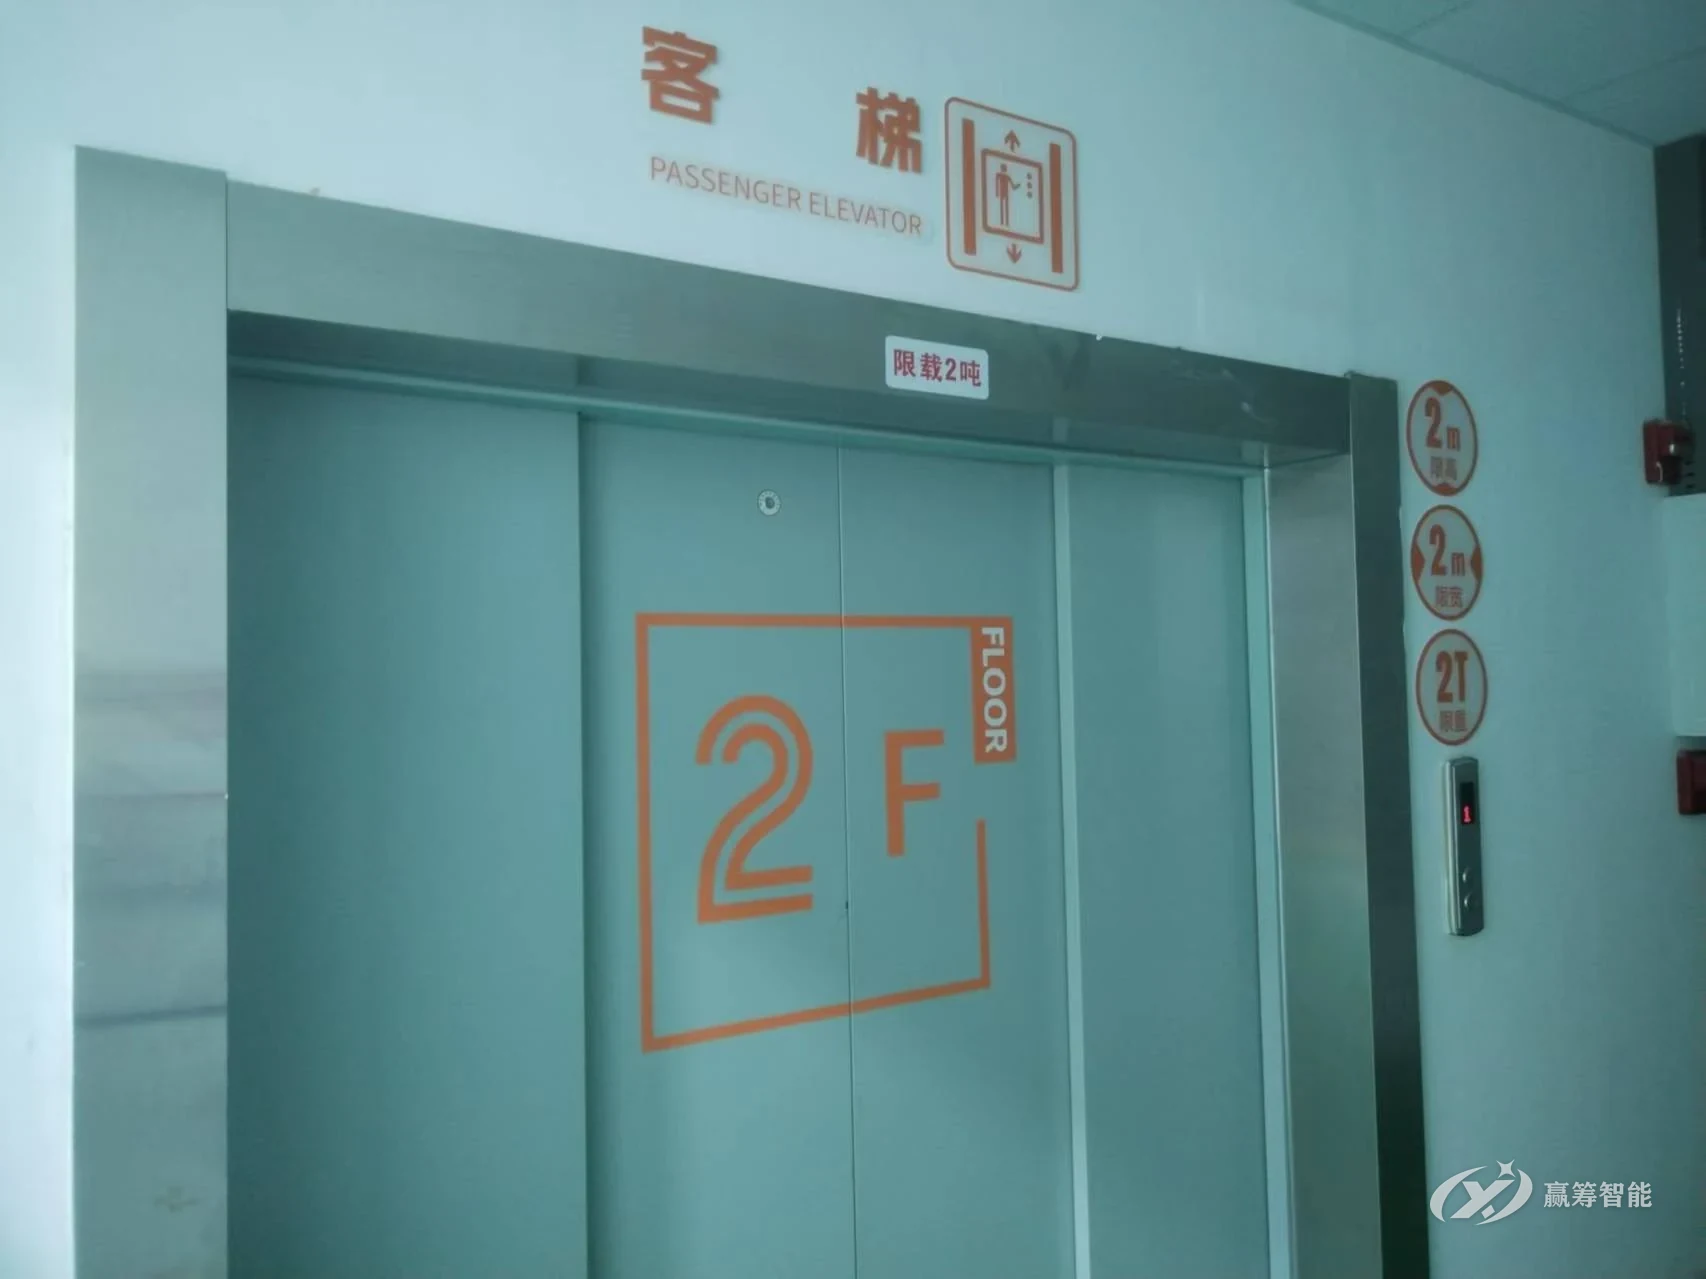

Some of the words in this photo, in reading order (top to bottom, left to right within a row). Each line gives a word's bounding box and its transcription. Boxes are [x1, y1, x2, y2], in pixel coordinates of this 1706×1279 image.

[650, 155, 801, 210] PASSENGER
[809, 191, 922, 235] ELEVATOR
[893, 348, 982, 388] 限载2吨
[1428, 523, 1466, 577] 2m
[981, 625, 1008, 753] FLOOR
[1435, 651, 1468, 703] 2T
